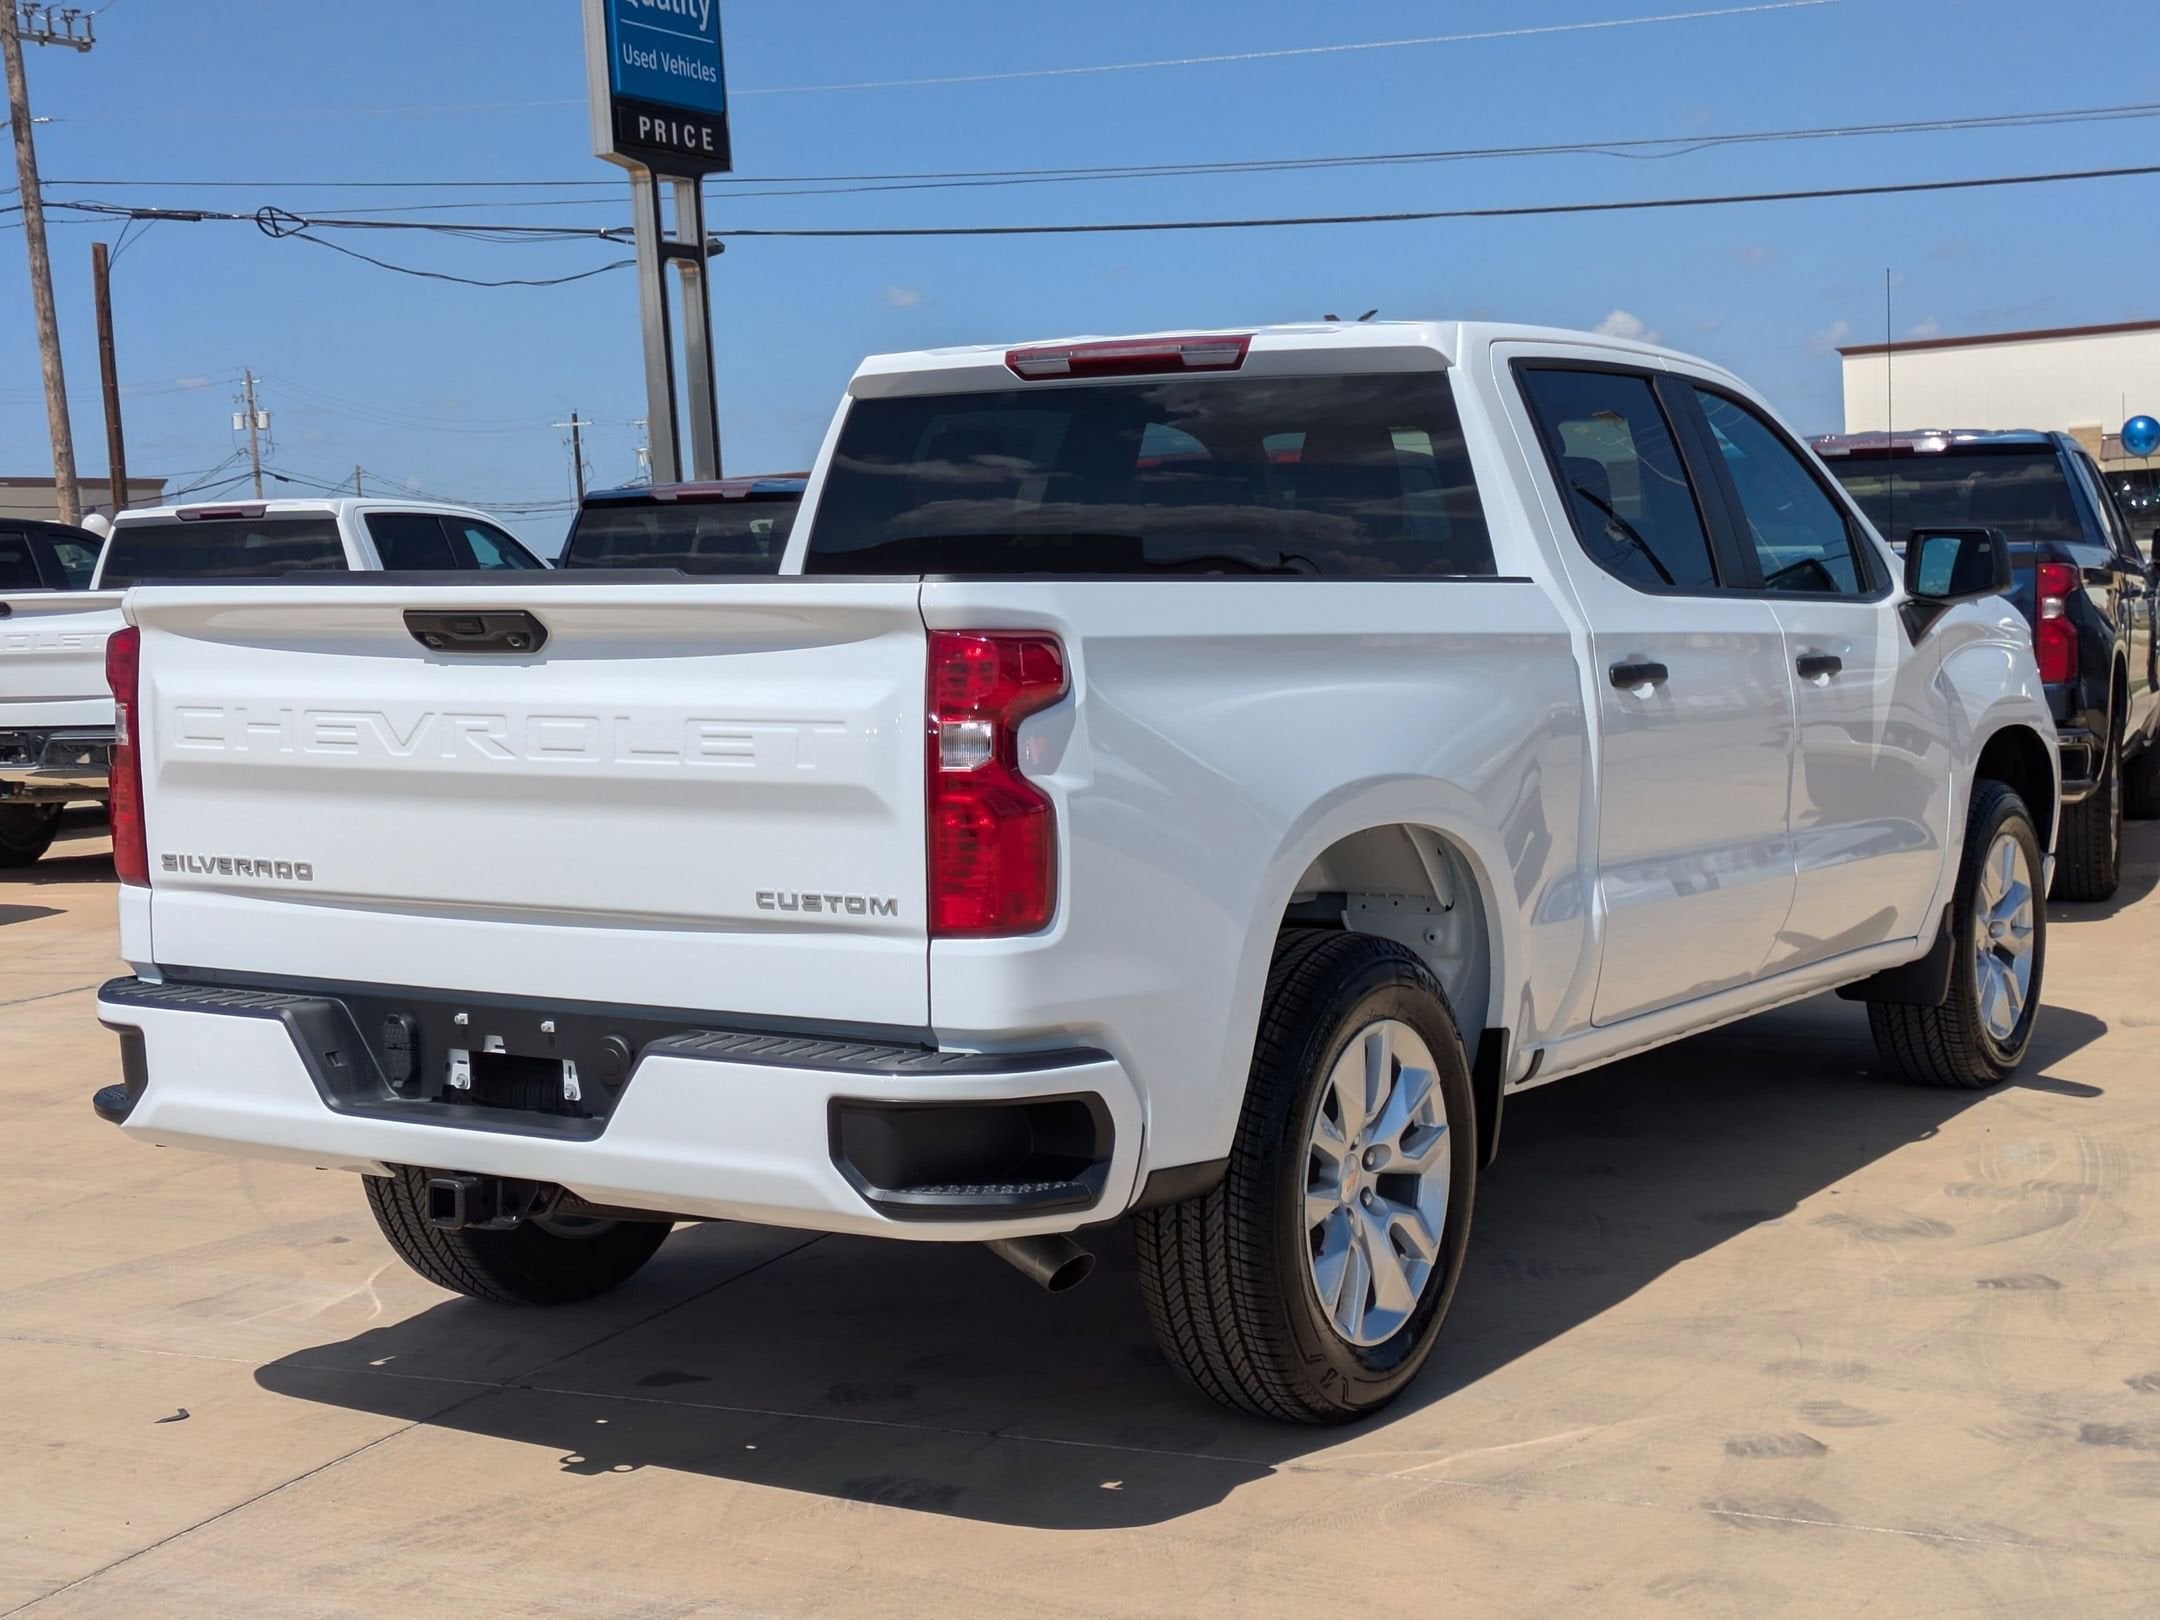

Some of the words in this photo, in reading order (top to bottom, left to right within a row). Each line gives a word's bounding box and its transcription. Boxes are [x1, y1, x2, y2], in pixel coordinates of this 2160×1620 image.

[627, 0, 711, 31] ality
[622, 43, 657, 70] Used
[660, 51, 717, 83] Vehicles
[638, 115, 714, 150] PRICE
[0, 632, 109, 651] OLET
[174, 705, 847, 769] CHEVROLET
[161, 853, 314, 881] SILVERADO
[755, 889, 899, 917] CUSTOM
